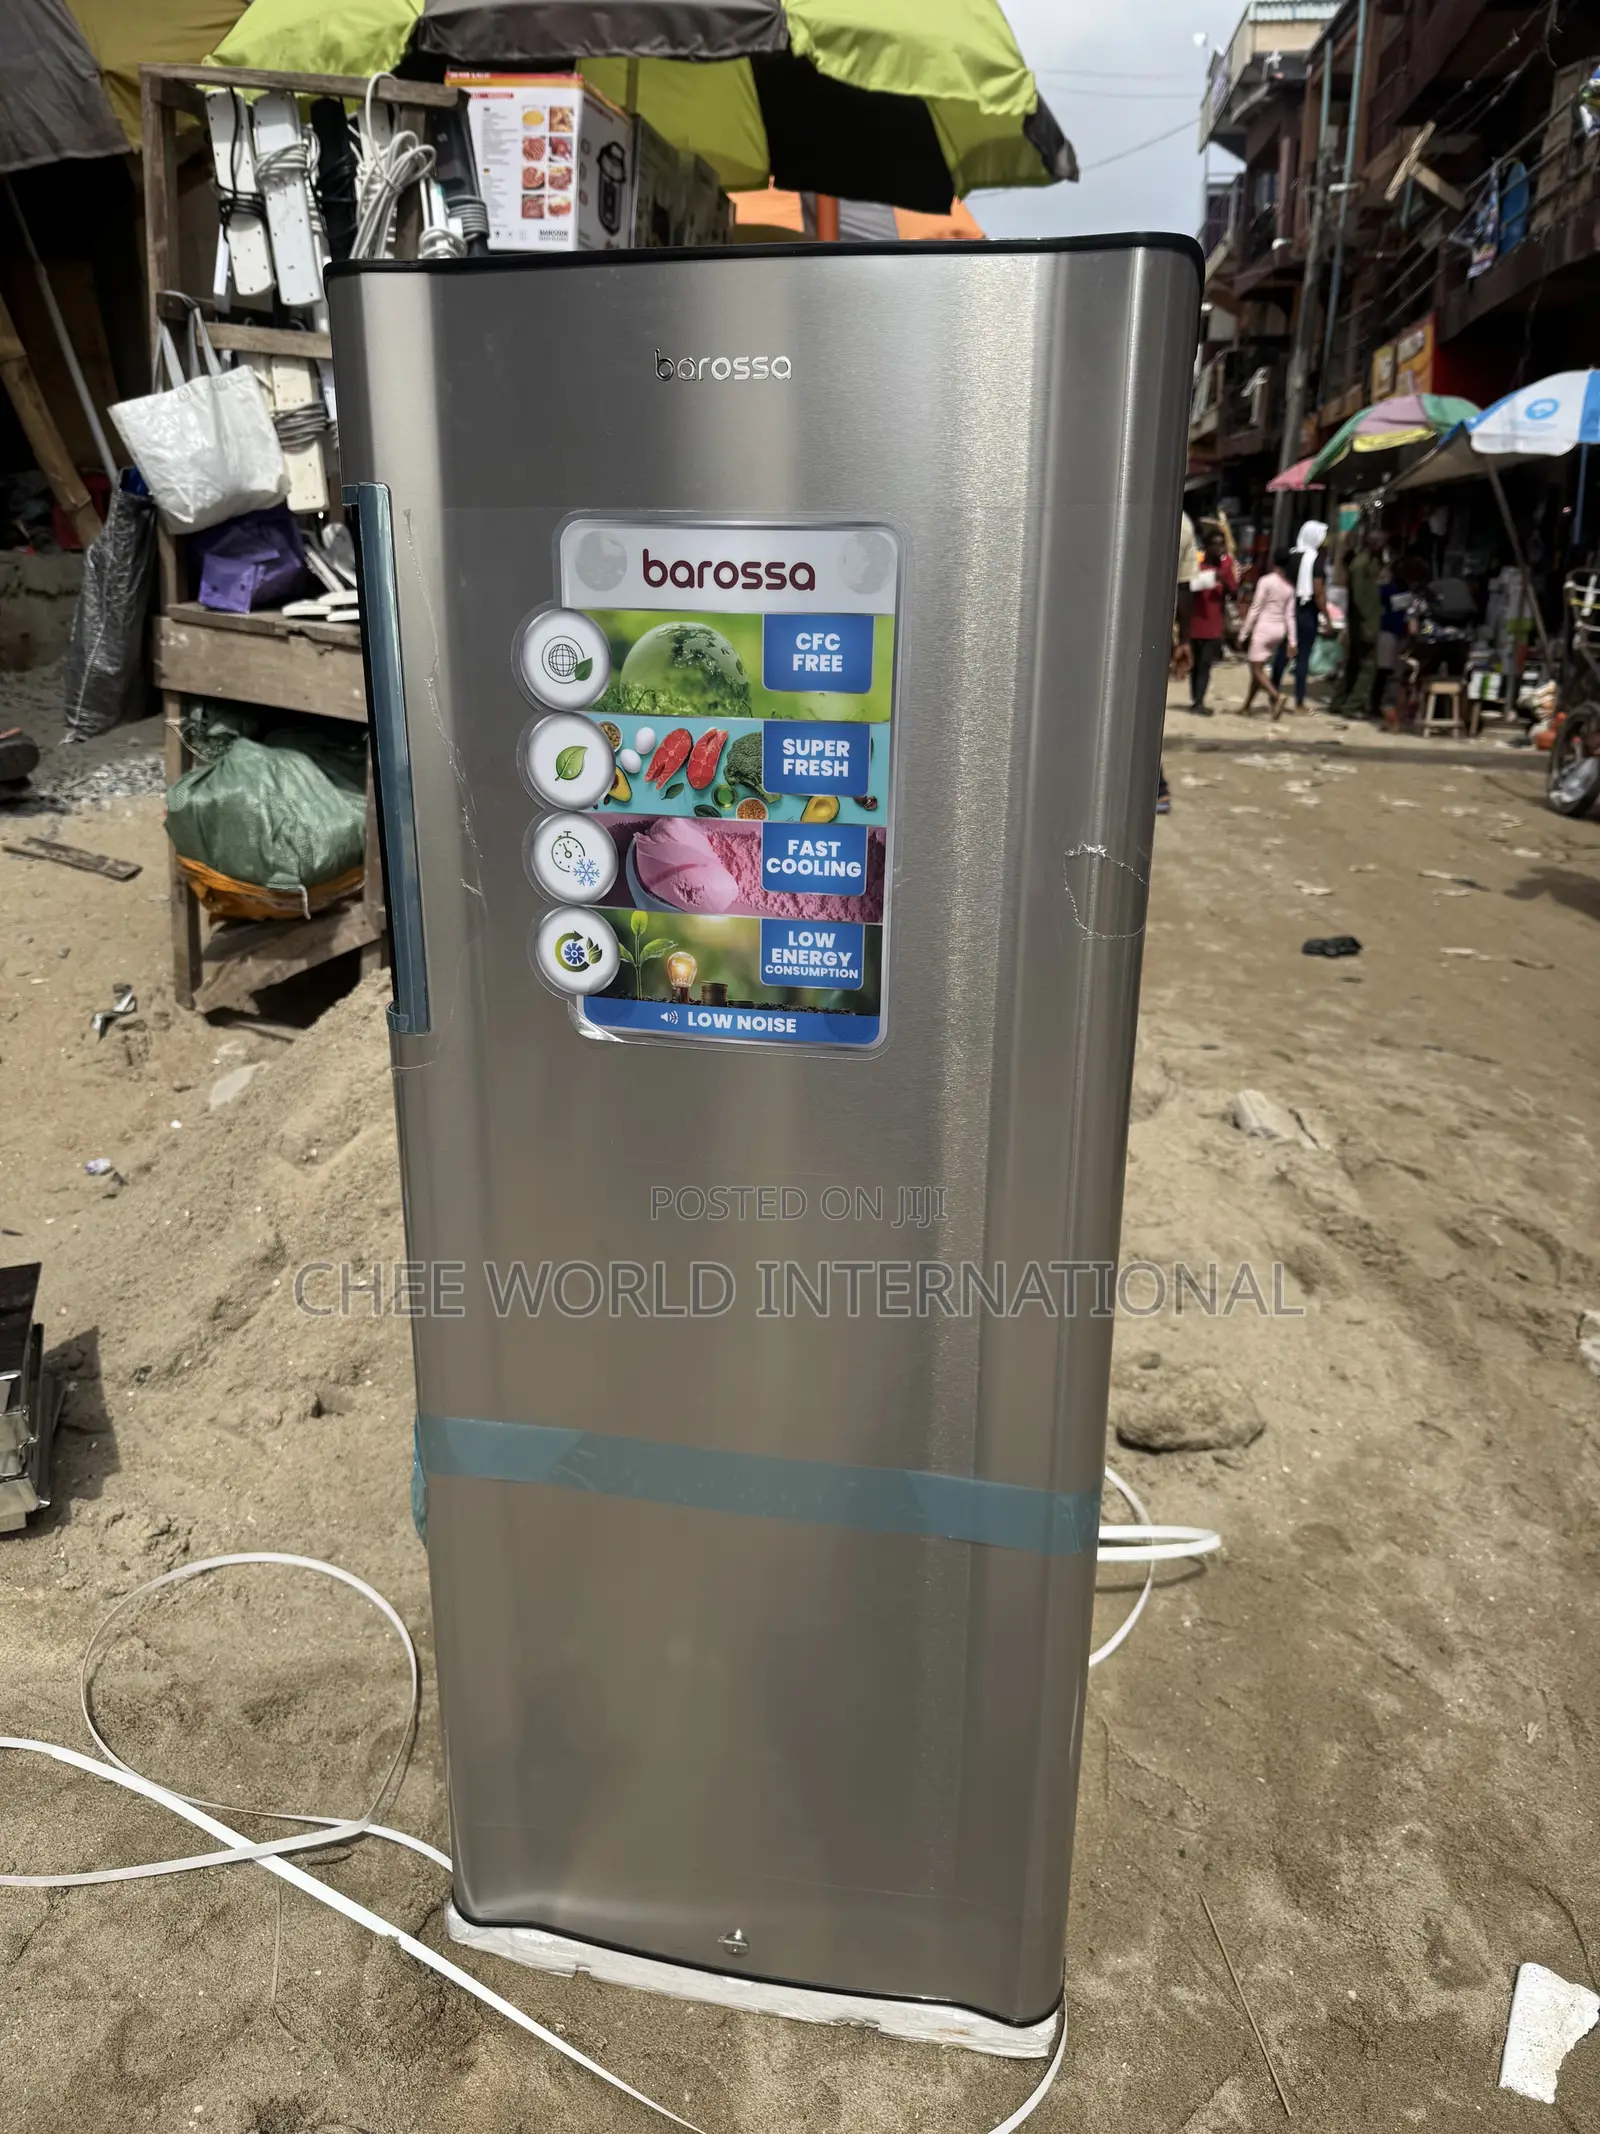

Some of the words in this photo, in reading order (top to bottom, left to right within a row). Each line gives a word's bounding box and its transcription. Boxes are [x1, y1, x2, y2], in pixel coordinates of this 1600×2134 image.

[654, 348, 793, 382] barossa
[642, 548, 816, 591] barossa
[795, 632, 841, 651] CFC
[792, 653, 843, 673] FREE
[782, 739, 850, 758] SUPER
[783, 759, 849, 778] FRESH
[787, 839, 841, 857] FAST
[765, 857, 862, 878] COOLING
[788, 930, 836, 948] LOW
[771, 949, 853, 968] ENERGY
[764, 965, 859, 980] CONSUMPTION
[687, 1011, 734, 1029] LOW
[736, 1015, 797, 1034] NOISE
